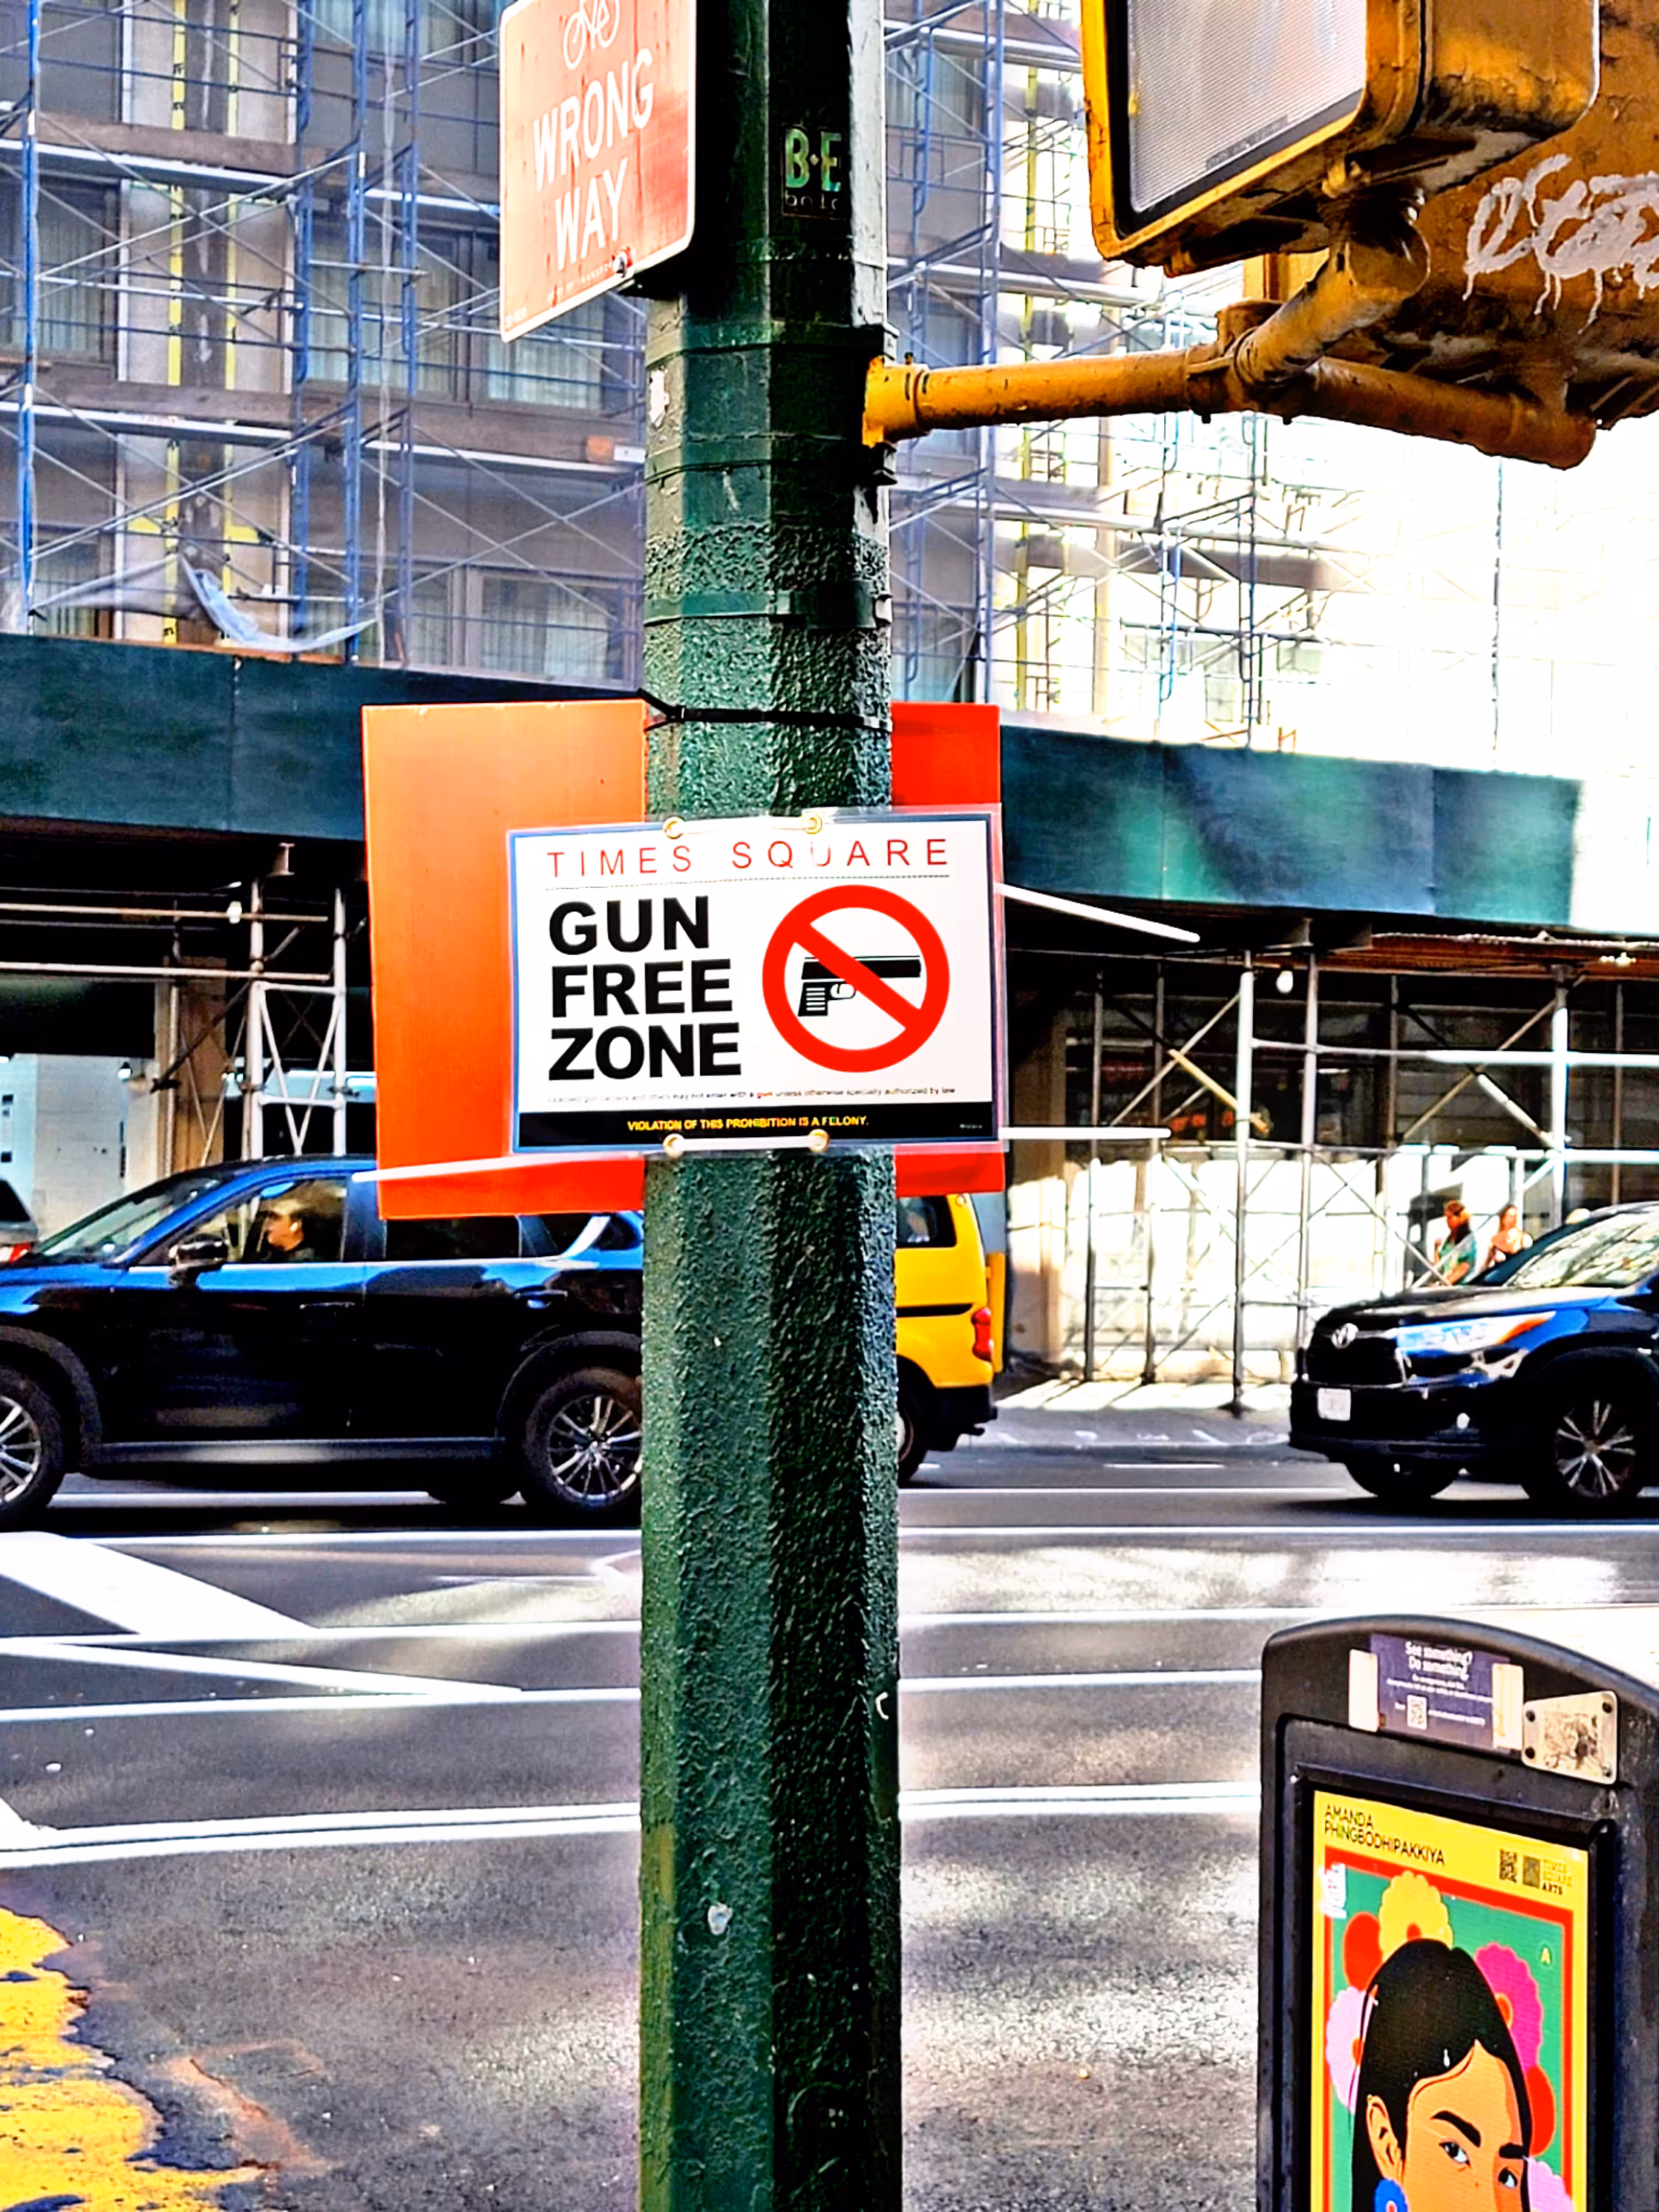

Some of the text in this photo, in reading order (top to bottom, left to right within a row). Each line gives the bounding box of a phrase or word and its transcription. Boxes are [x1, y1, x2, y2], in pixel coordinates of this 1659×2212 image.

[533, 49, 654, 191] WRONG
[555, 158, 628, 270] WAY
[547, 838, 948, 878] TIMES SQUARE
[549, 895, 710, 956] GUN
[551, 958, 733, 1018] FREE
[549, 1022, 742, 1081] ZONE
[757, 1091, 773, 1099] gun
[885, 1086, 927, 1095] authorized
[627, 1115, 869, 1131] VIOLATION OF THIS PROHIBITION IS A FELONY.
[1324, 1819, 1445, 1867] PHINGBODHIPAKKIYA
[1325, 1804, 1374, 1830] AMANDA
